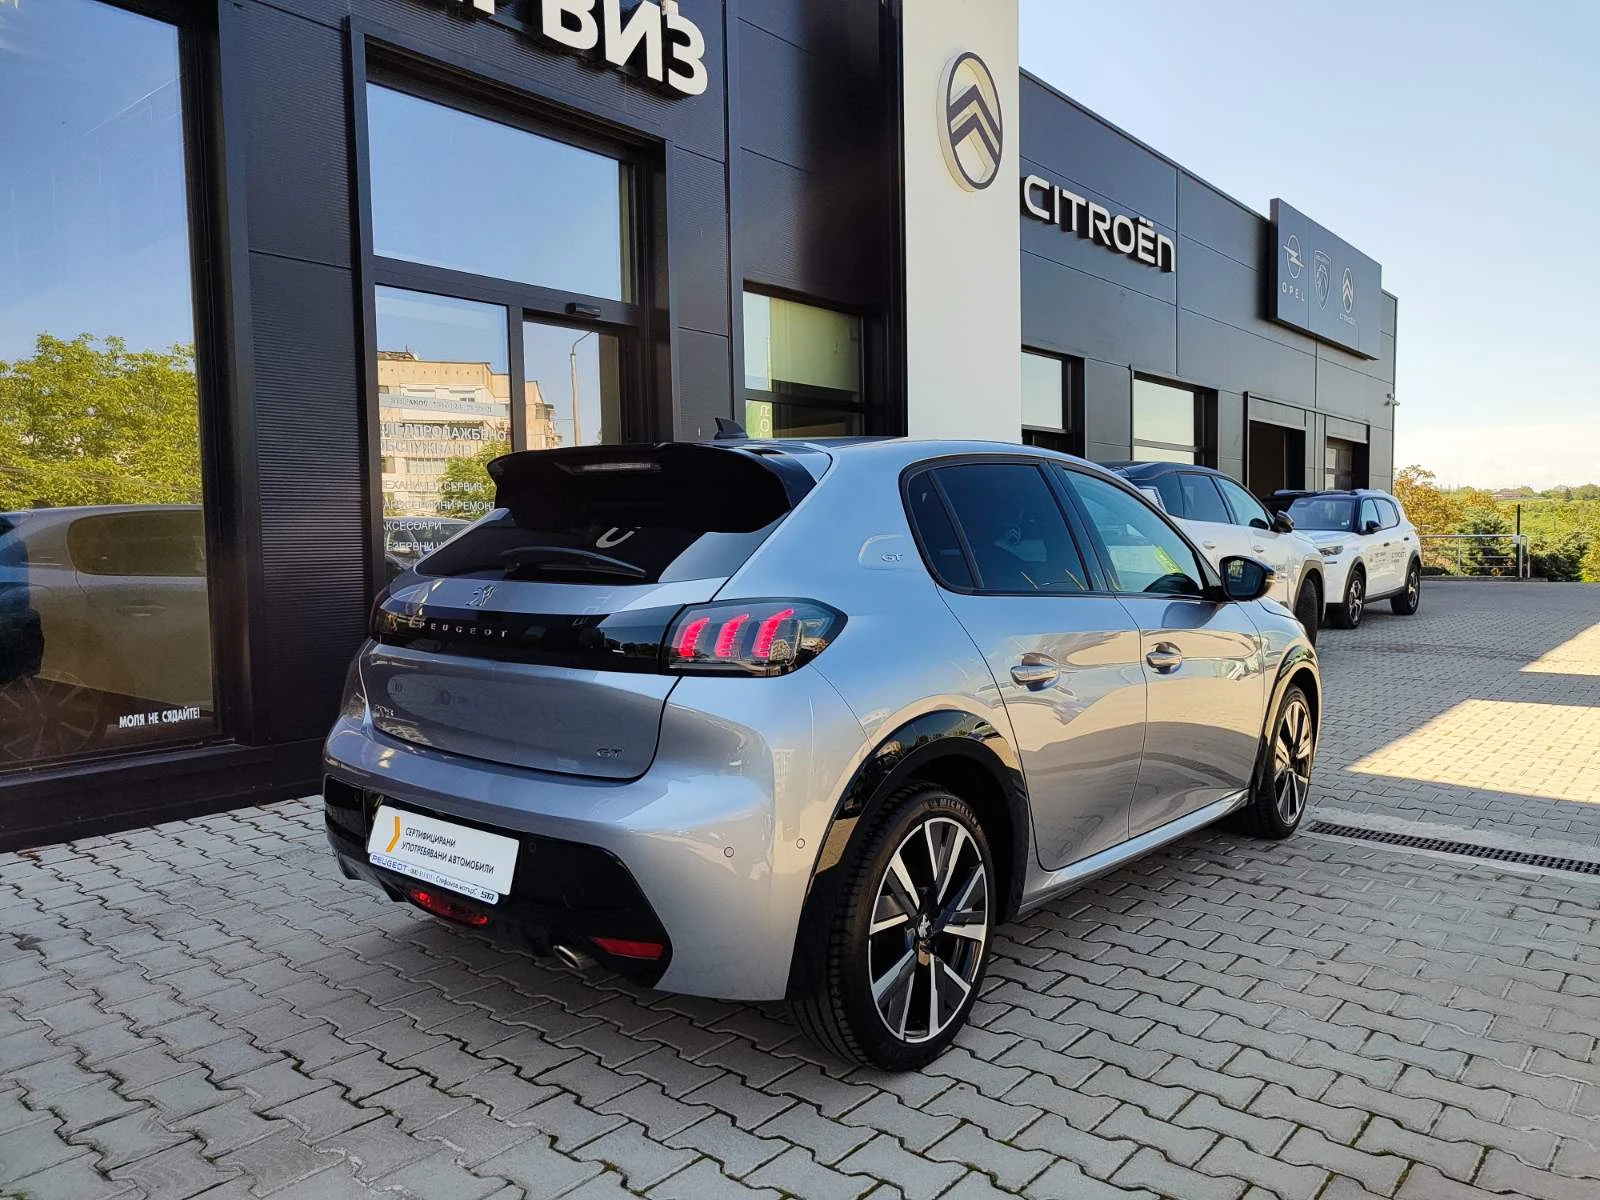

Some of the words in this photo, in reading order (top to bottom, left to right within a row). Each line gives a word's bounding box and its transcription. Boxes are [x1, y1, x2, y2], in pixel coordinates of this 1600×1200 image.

[1024, 174, 1175, 272] CITROËN
[1282, 282, 1305, 302] OPEL
[380, 422, 506, 441] ЛЕДПРОДАЖБЕНО
[443, 481, 483, 492] СЕРВИЗ
[386, 541, 434, 552] ЕЗЕРВНИ
[880, 553, 903, 562] GT
[418, 621, 509, 638] PEUGEOT
[119, 713, 145, 728] МОЛЯ
[148, 712, 159, 725] НЕ
[162, 706, 200, 723] СЯДАЙТЕ!
[596, 747, 624, 759] GT
[405, 827, 456, 848] СЕРТИФИЦИРАНИ
[371, 854, 408, 871] PEUGEOT
[401, 840, 447, 861] УПОТРЕБЯВАНИ
[447, 855, 495, 875] АВТОМОБИЛИ
